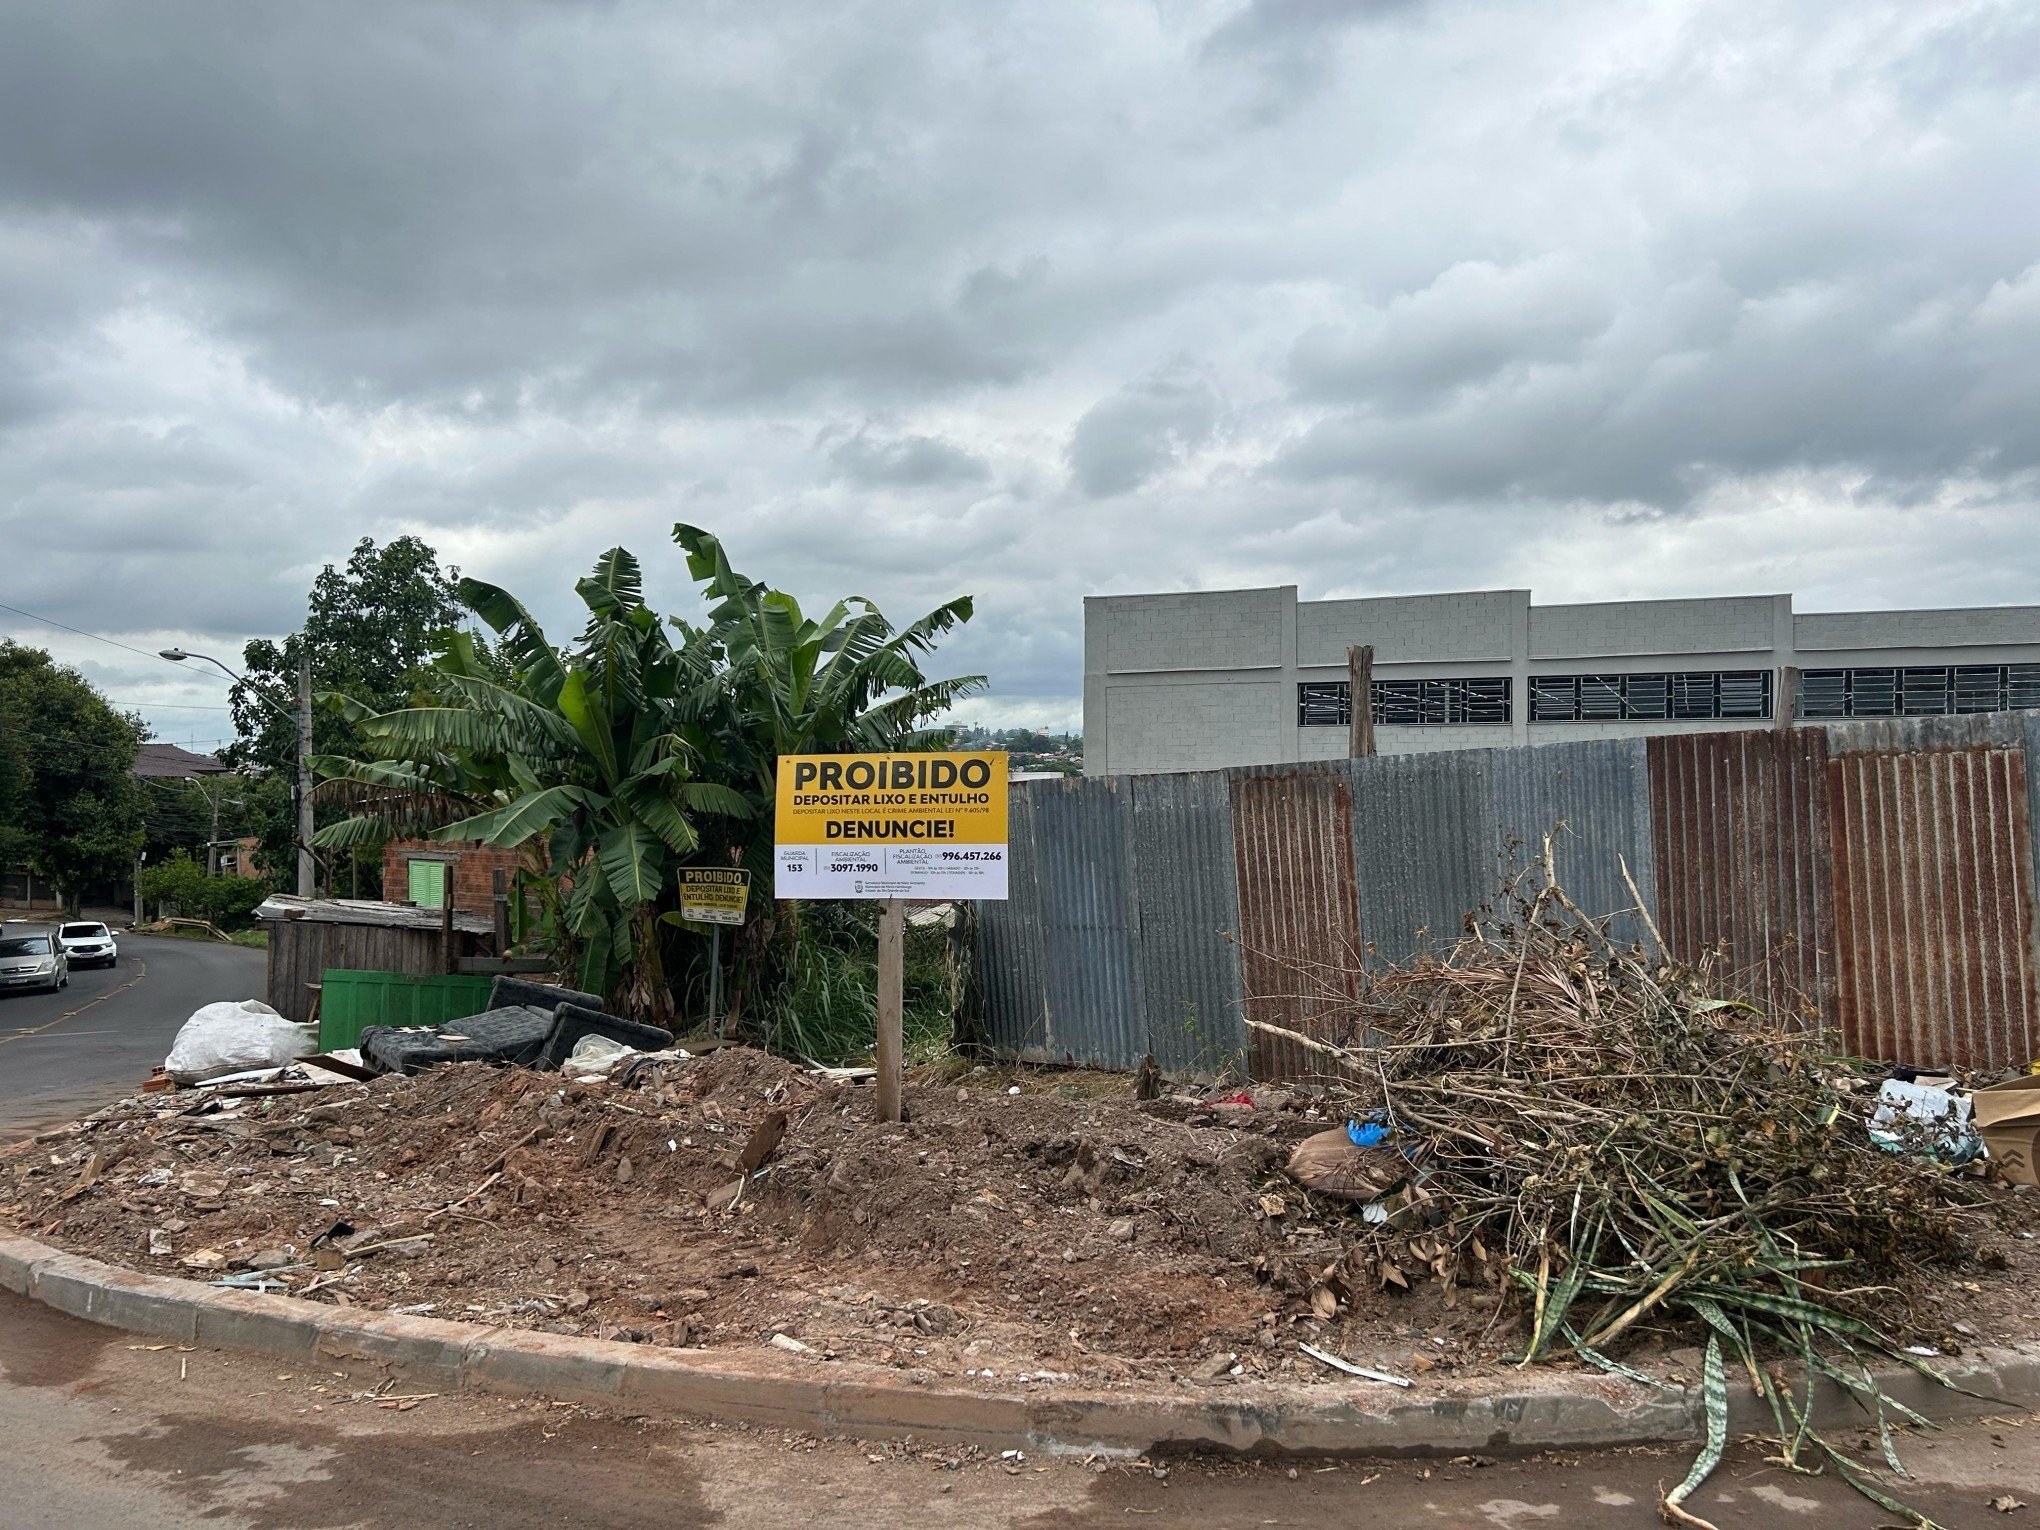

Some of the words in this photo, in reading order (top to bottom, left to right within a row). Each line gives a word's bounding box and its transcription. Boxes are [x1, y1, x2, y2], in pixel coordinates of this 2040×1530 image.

[794, 759, 990, 790] PROIBIDO
[794, 794, 870, 806] DEPOSITAR
[874, 794, 905, 804] LIXO
[909, 794, 916, 804] E
[920, 793, 990, 804] ENTULHO
[826, 820, 955, 838] DENUNCIE!
[942, 852, 1002, 860] 996.457.266
[831, 864, 878, 872] 3097.1990
[685, 871, 742, 884] PROIBIDO
